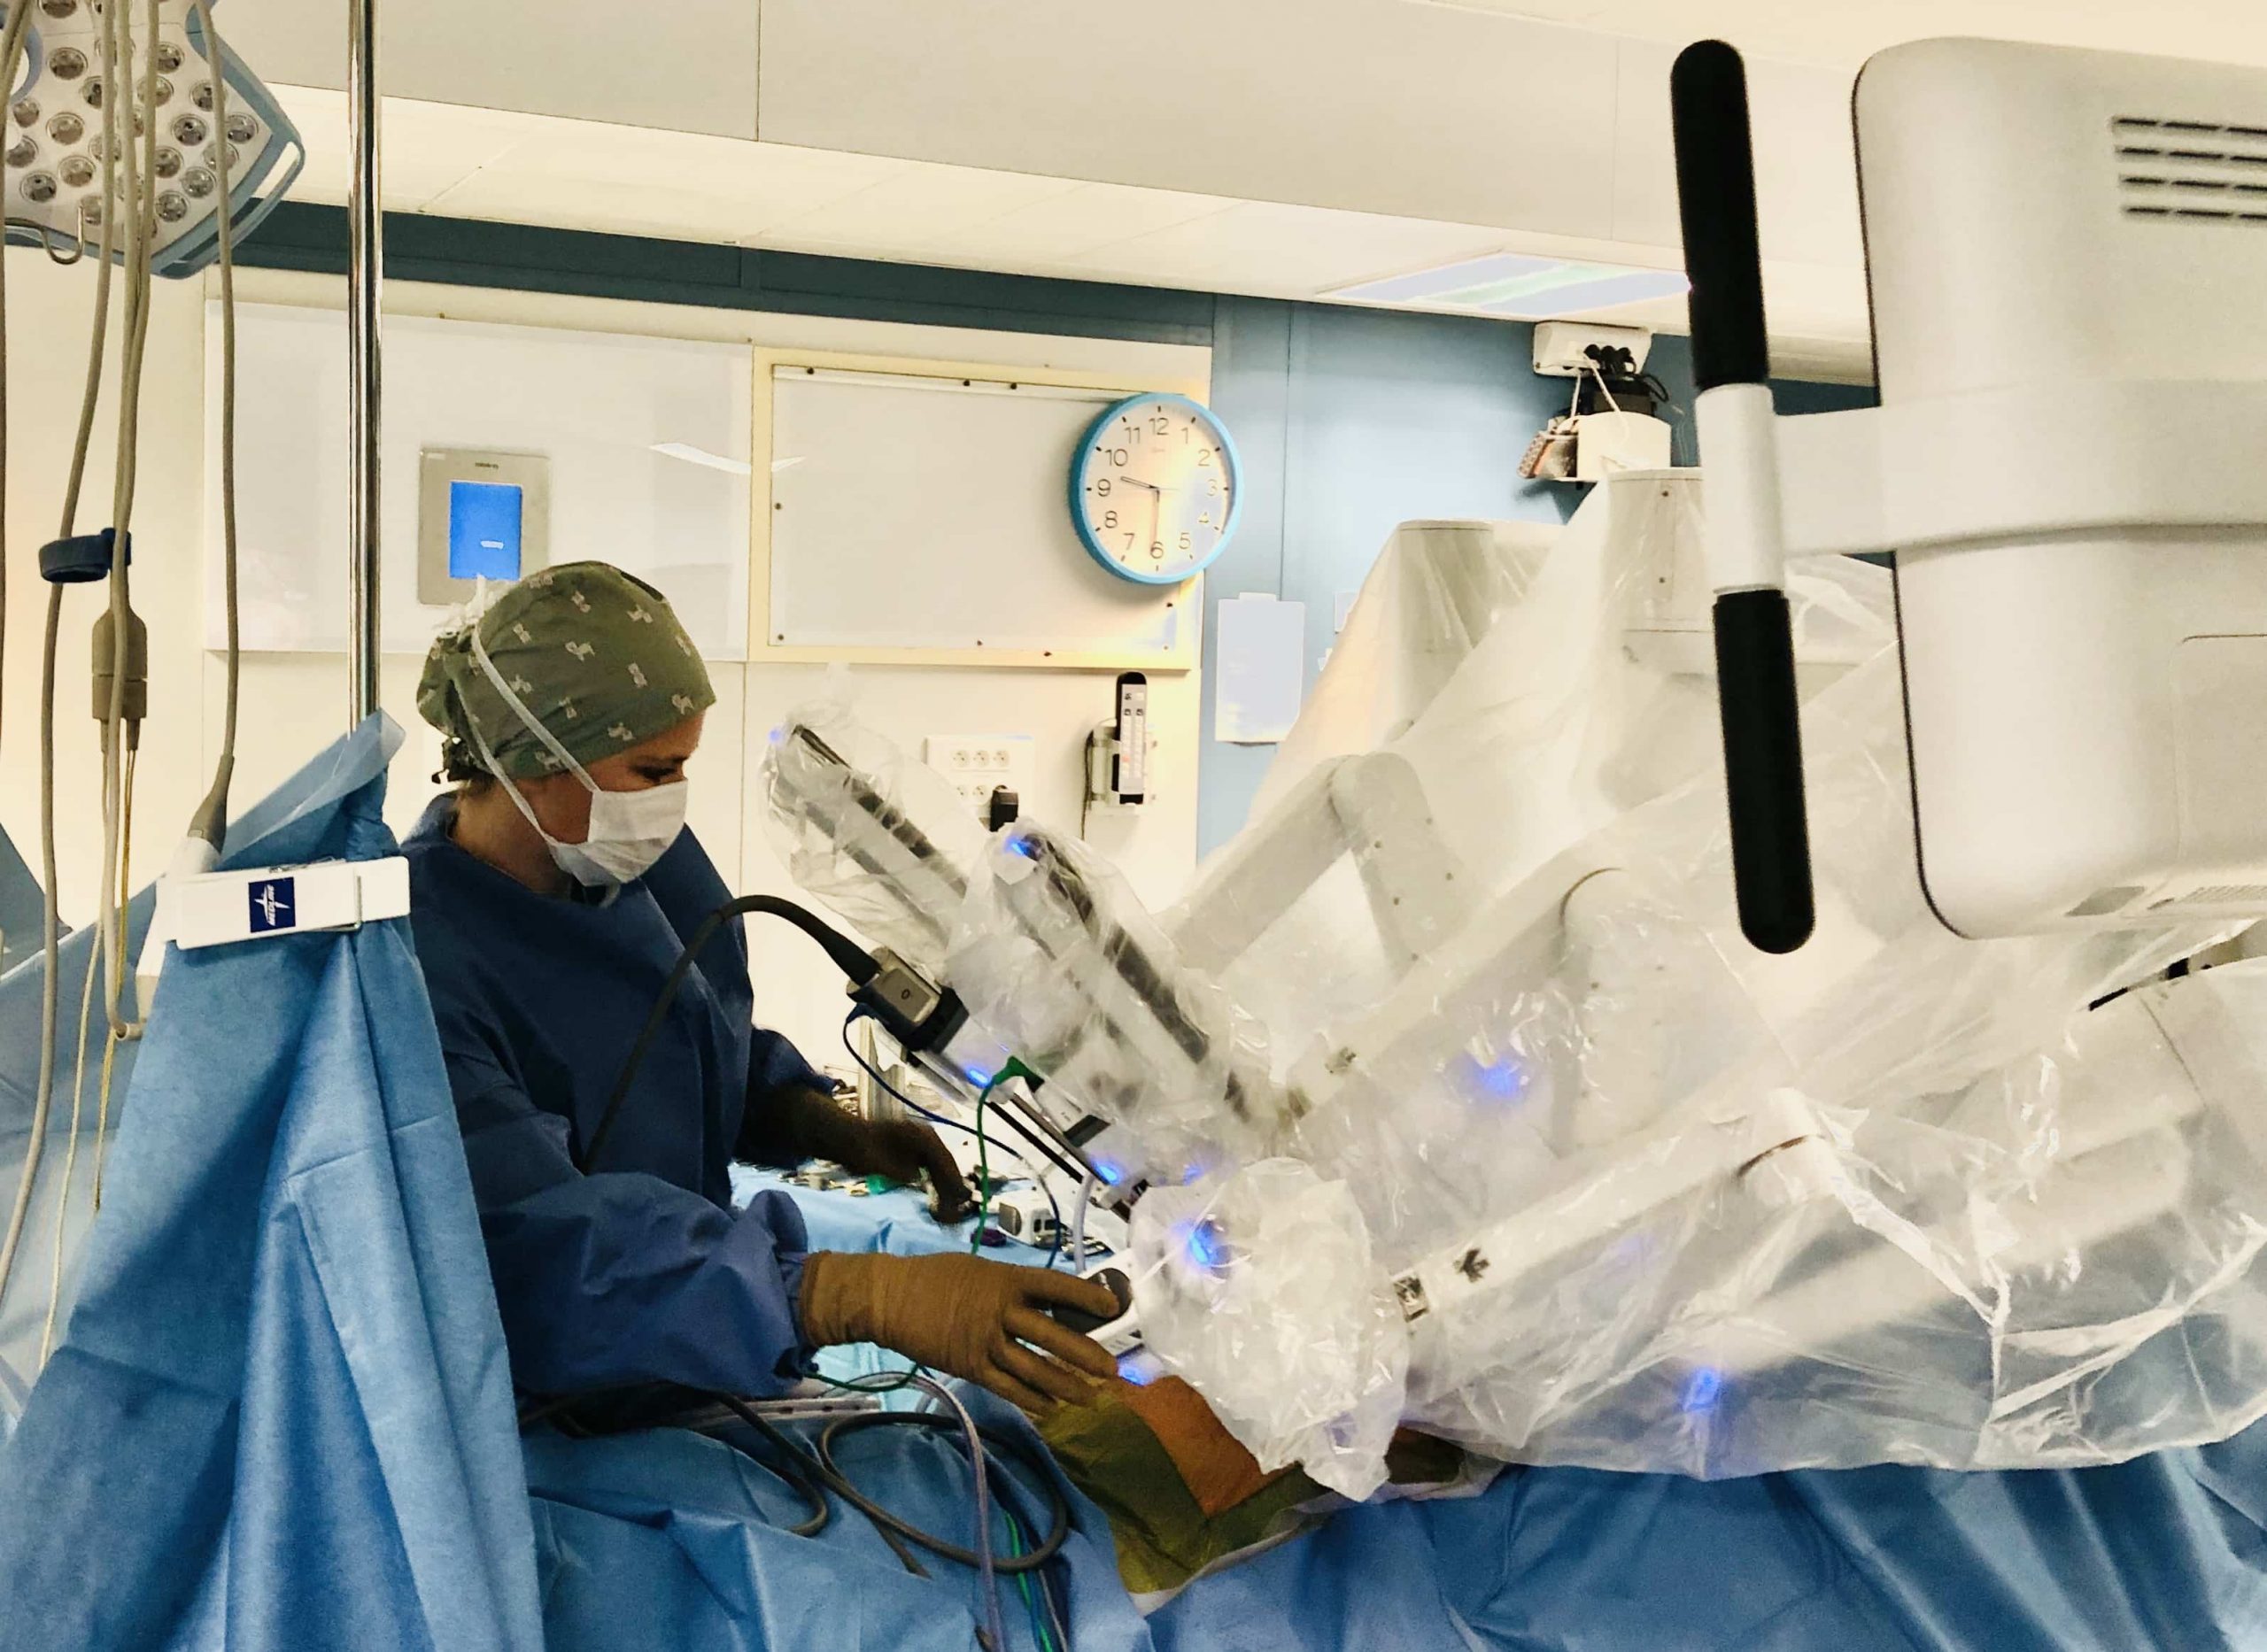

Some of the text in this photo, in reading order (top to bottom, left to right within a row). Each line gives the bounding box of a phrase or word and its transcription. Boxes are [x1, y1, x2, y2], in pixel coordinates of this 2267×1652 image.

[1125, 427, 1141, 444] 11
[1149, 418, 1169, 436] 12
[1180, 428, 1188, 444] 1
[1105, 449, 1128, 467] 10
[1198, 449, 1211, 467] 2
[1097, 479, 1111, 497] 9
[1207, 479, 1219, 496] 3
[1104, 511, 1118, 529] 8
[1199, 513, 1210, 525] 4
[1124, 533, 1135, 550] 7
[1179, 532, 1191, 549] 5
[1151, 542, 1164, 559] 6
